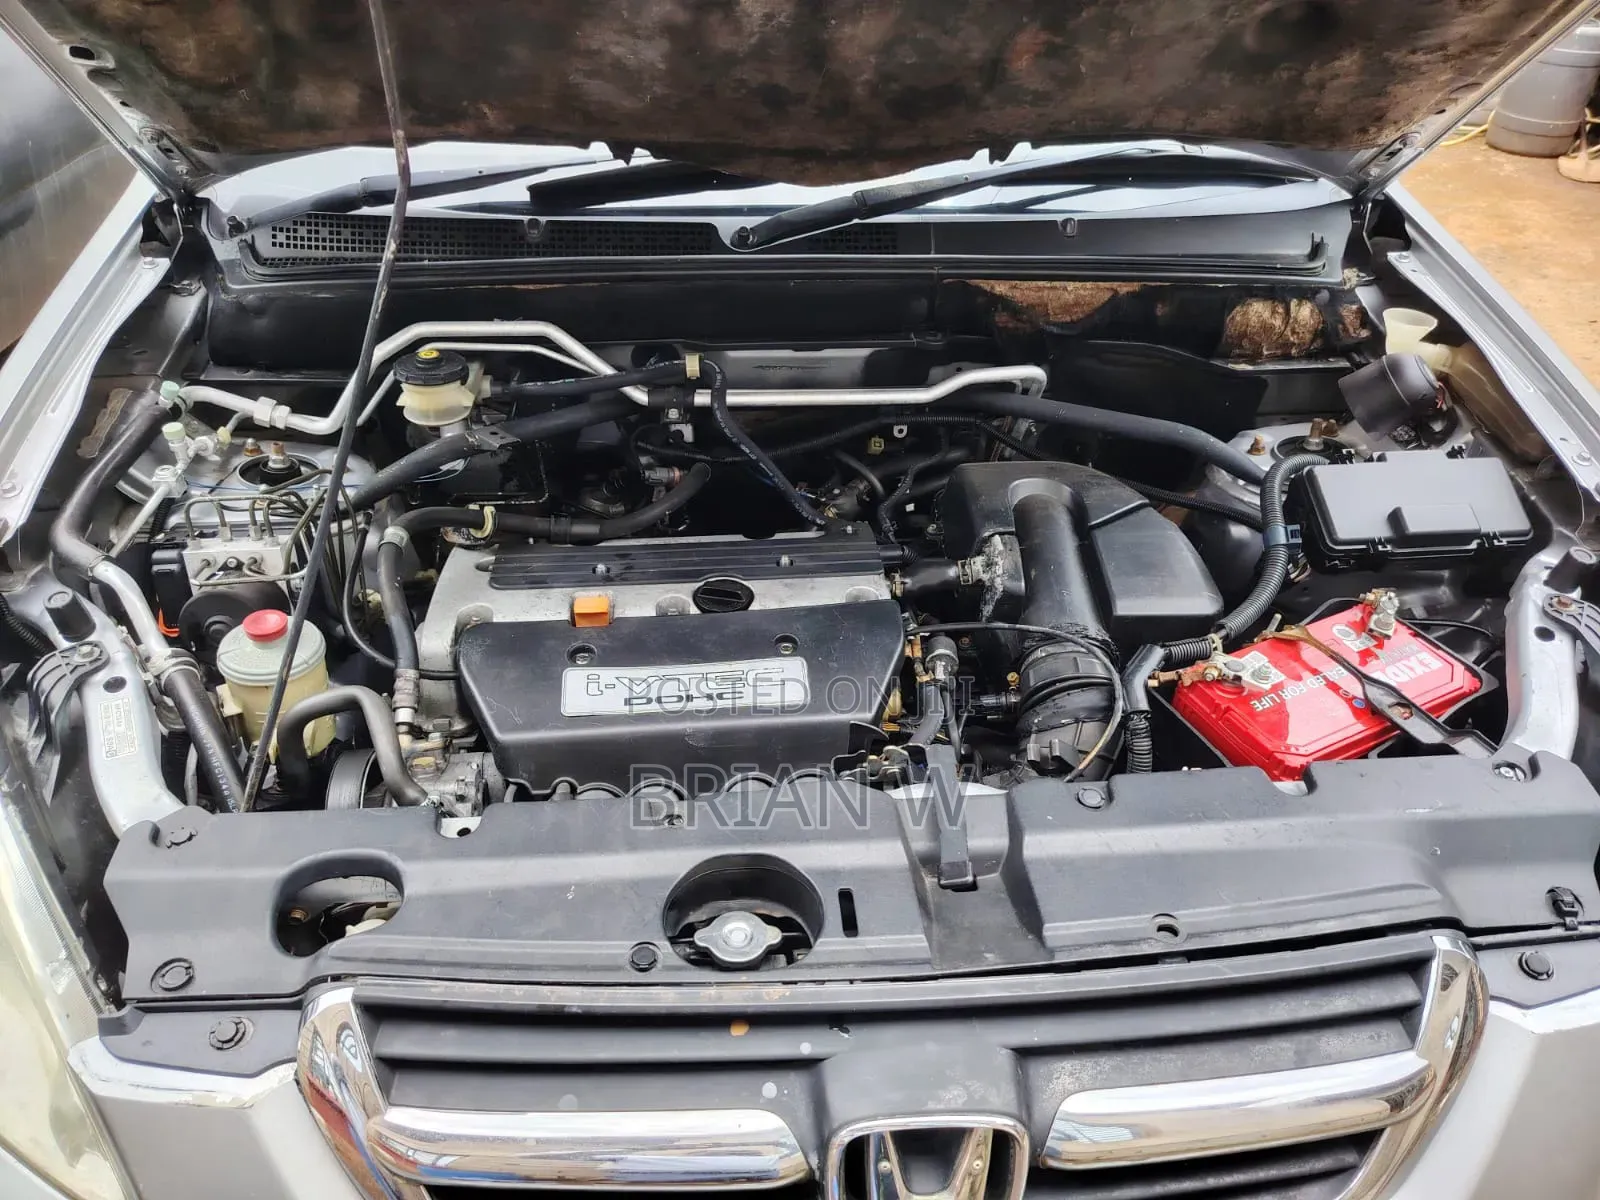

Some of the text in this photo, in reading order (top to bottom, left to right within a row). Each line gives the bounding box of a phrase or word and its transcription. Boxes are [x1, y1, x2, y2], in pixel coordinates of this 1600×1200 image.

[586, 667, 786, 697] i-VTEC
[1250, 666, 1348, 712] EALED FOR LIFE
[623, 690, 745, 707] DOHC
